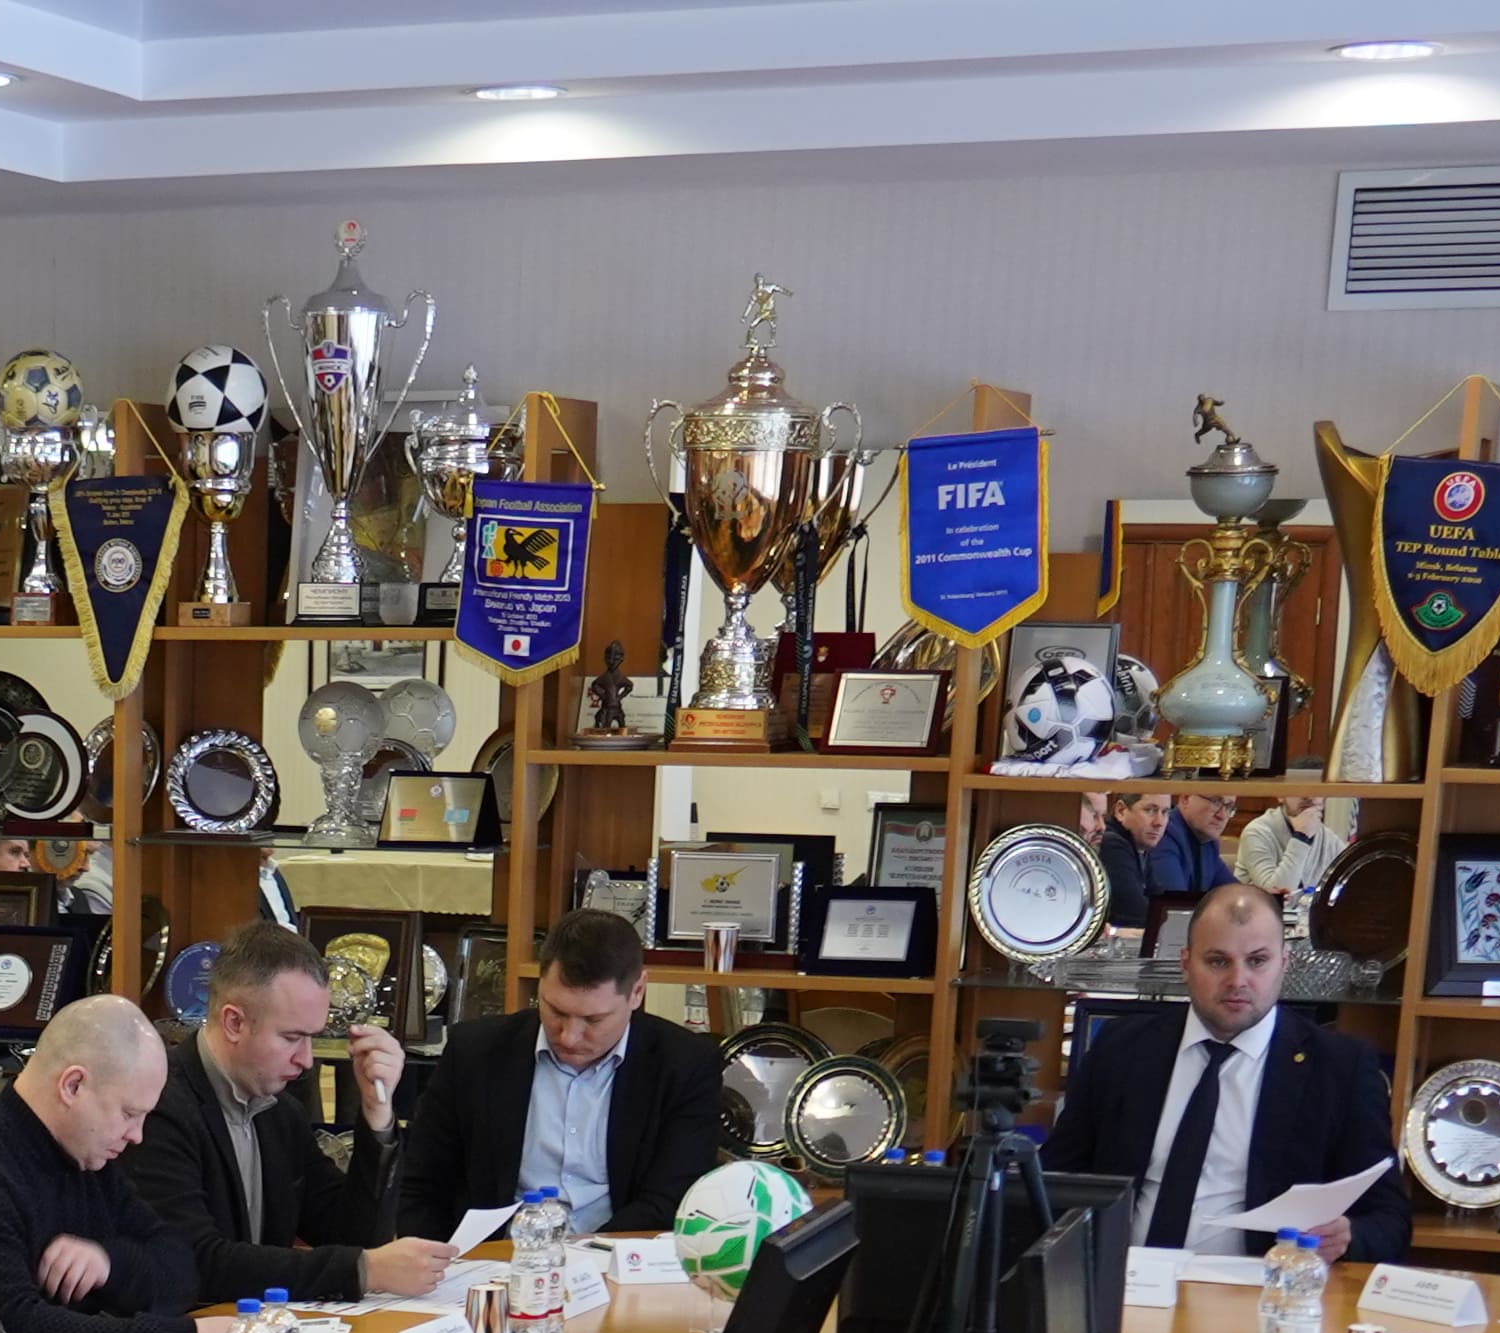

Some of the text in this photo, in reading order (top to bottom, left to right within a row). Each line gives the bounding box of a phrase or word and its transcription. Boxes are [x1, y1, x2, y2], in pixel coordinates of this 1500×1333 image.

[1446, 472, 1477, 490] UEFA
[938, 481, 1006, 511] FIFA
[498, 498, 533, 512] Football
[533, 500, 583, 513] Association
[955, 523, 1000, 535] celebration
[1429, 524, 1475, 542] UEFA
[971, 537, 985, 547] the
[1395, 540, 1422, 554] TEP
[1423, 542, 1468, 559] Round
[915, 546, 1033, 565] 2011 Commonwealth Cup
[528, 602, 557, 615] Japan
[1014, 853, 1053, 867] RUSSIA
